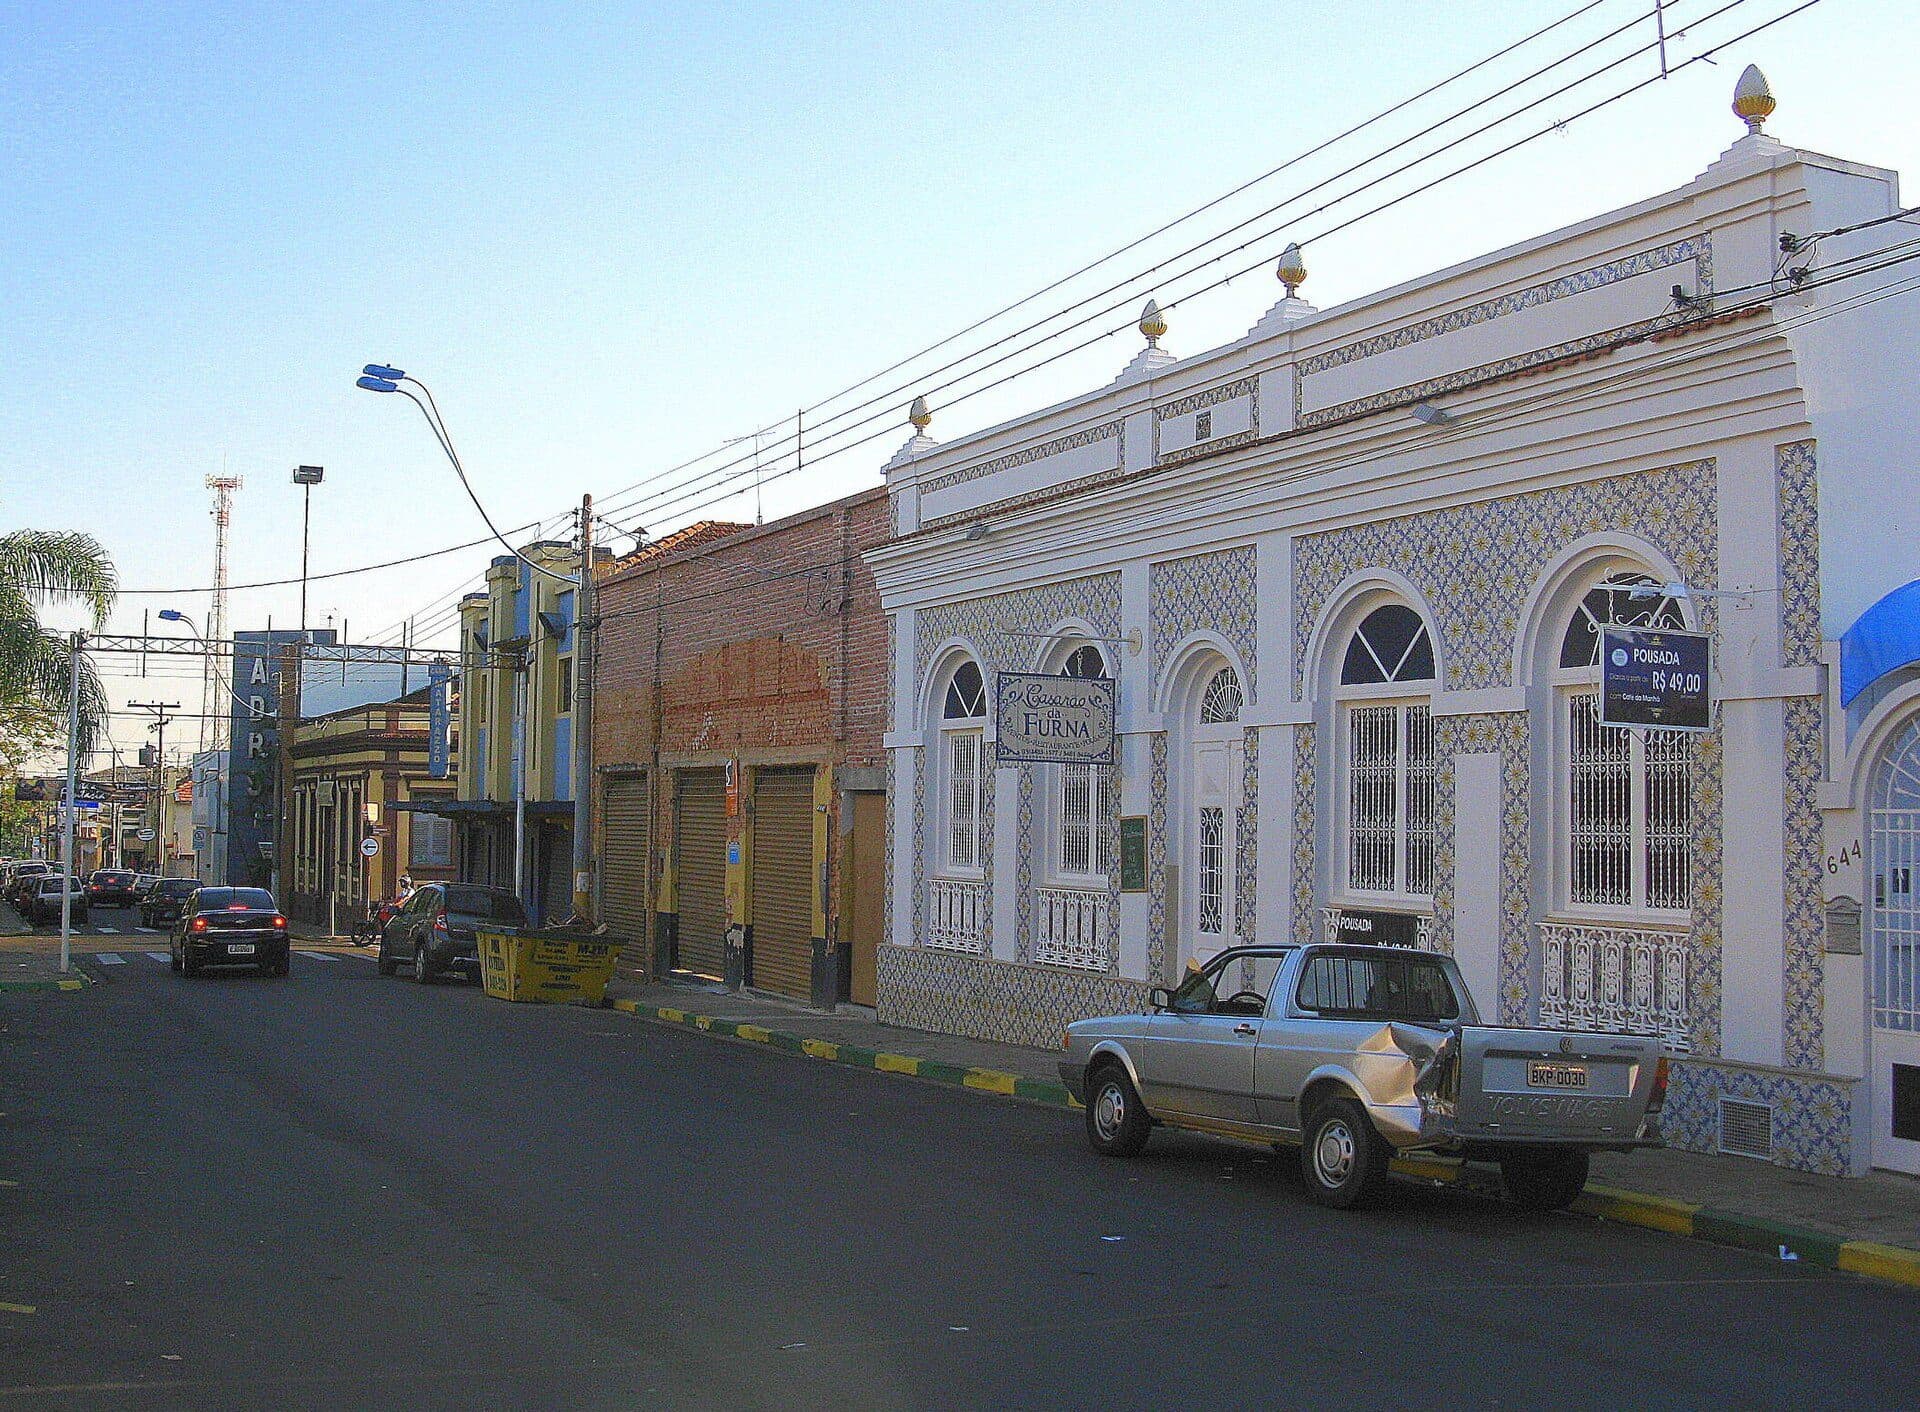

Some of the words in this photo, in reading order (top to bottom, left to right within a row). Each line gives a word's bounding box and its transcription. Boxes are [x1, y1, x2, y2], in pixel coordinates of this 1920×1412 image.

[1633, 648, 1680, 666] POUSADA
[1652, 670, 1666, 693] R$
[1669, 672, 1701, 694] 49,00
[434, 680, 443, 763] MATARAZZO
[1023, 712, 1090, 738] FURNA
[1047, 707, 1061, 719] da
[1827, 839, 1862, 874] 644
[1340, 917, 1372, 931] POUSADA
